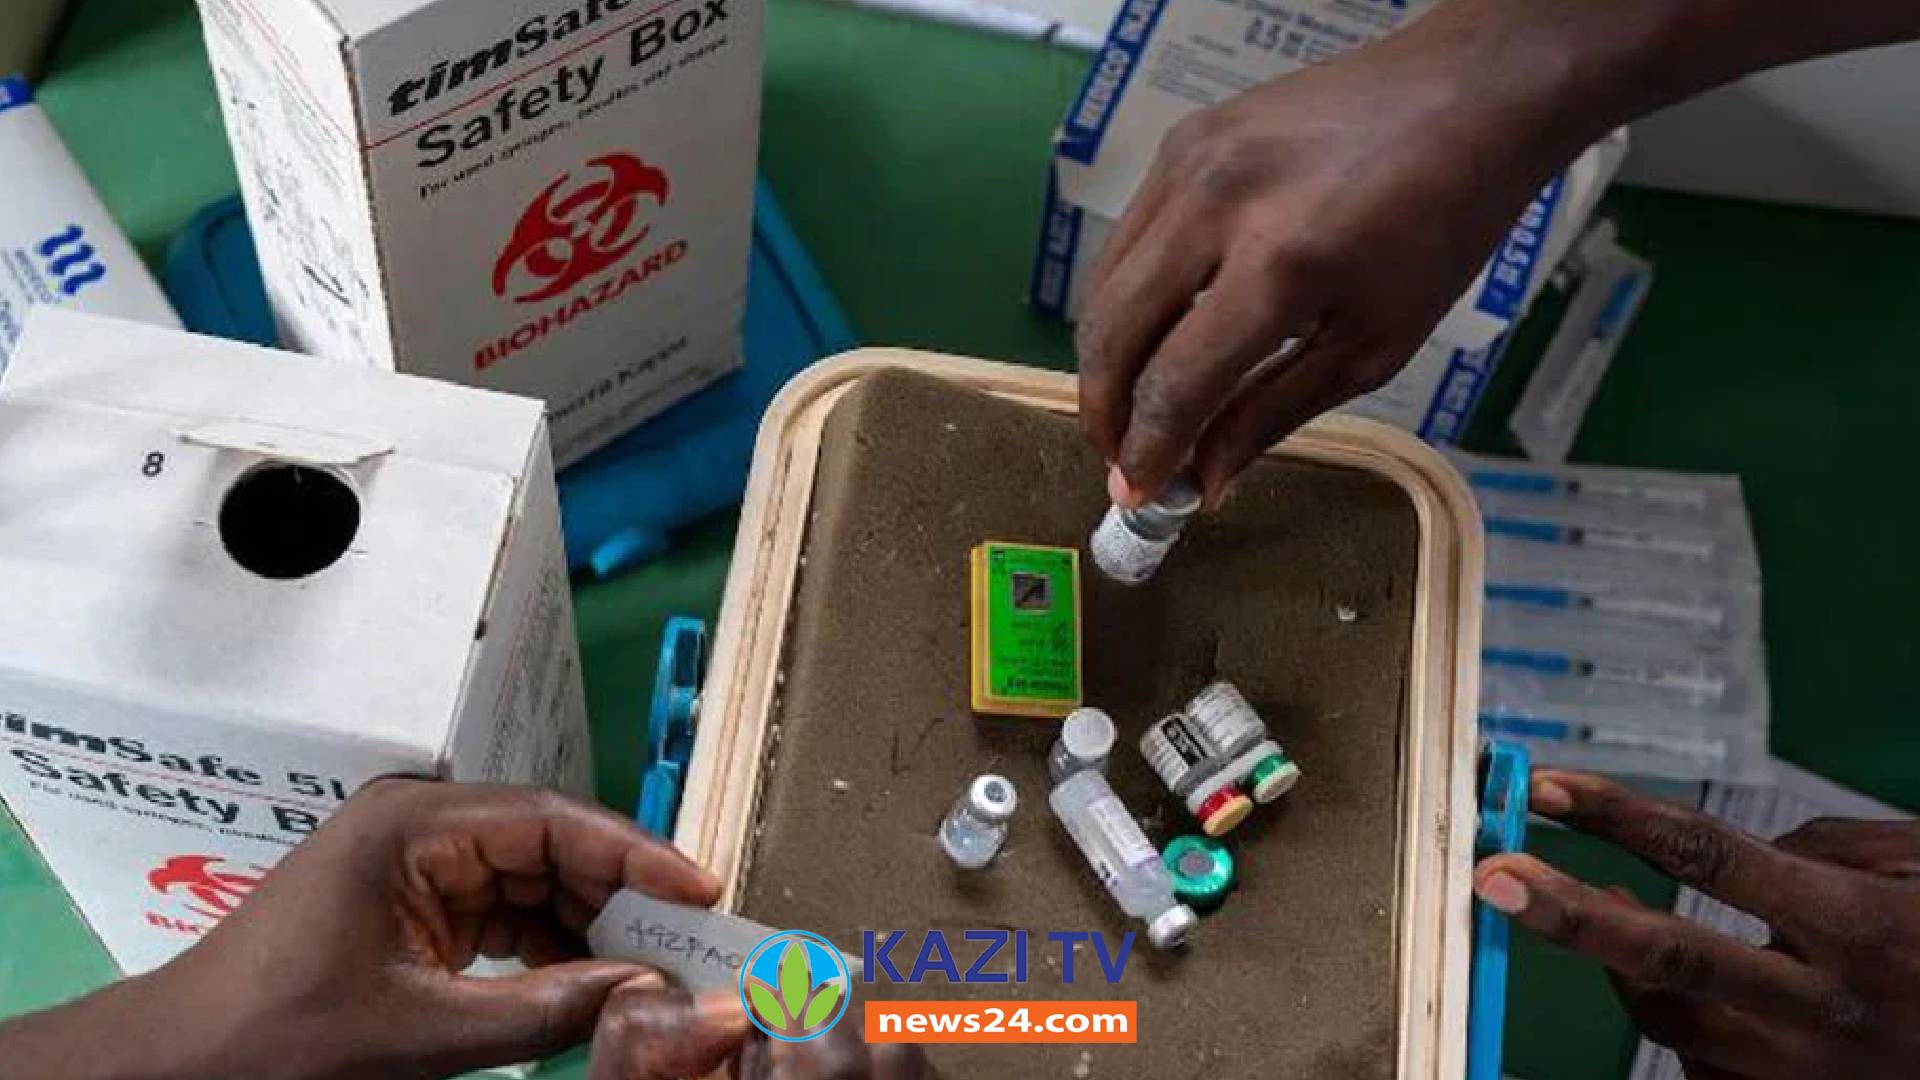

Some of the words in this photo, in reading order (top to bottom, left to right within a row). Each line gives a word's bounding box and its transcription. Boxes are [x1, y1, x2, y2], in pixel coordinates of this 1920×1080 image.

[417, 55, 605, 168] Safety
[629, 0, 729, 67] Box
[473, 239, 690, 372] BIOHAZARD
[142, 450, 165, 478] 8
[0, 712, 263, 786] imSafe
[11, 749, 239, 823] Safety
[271, 806, 319, 832] B
